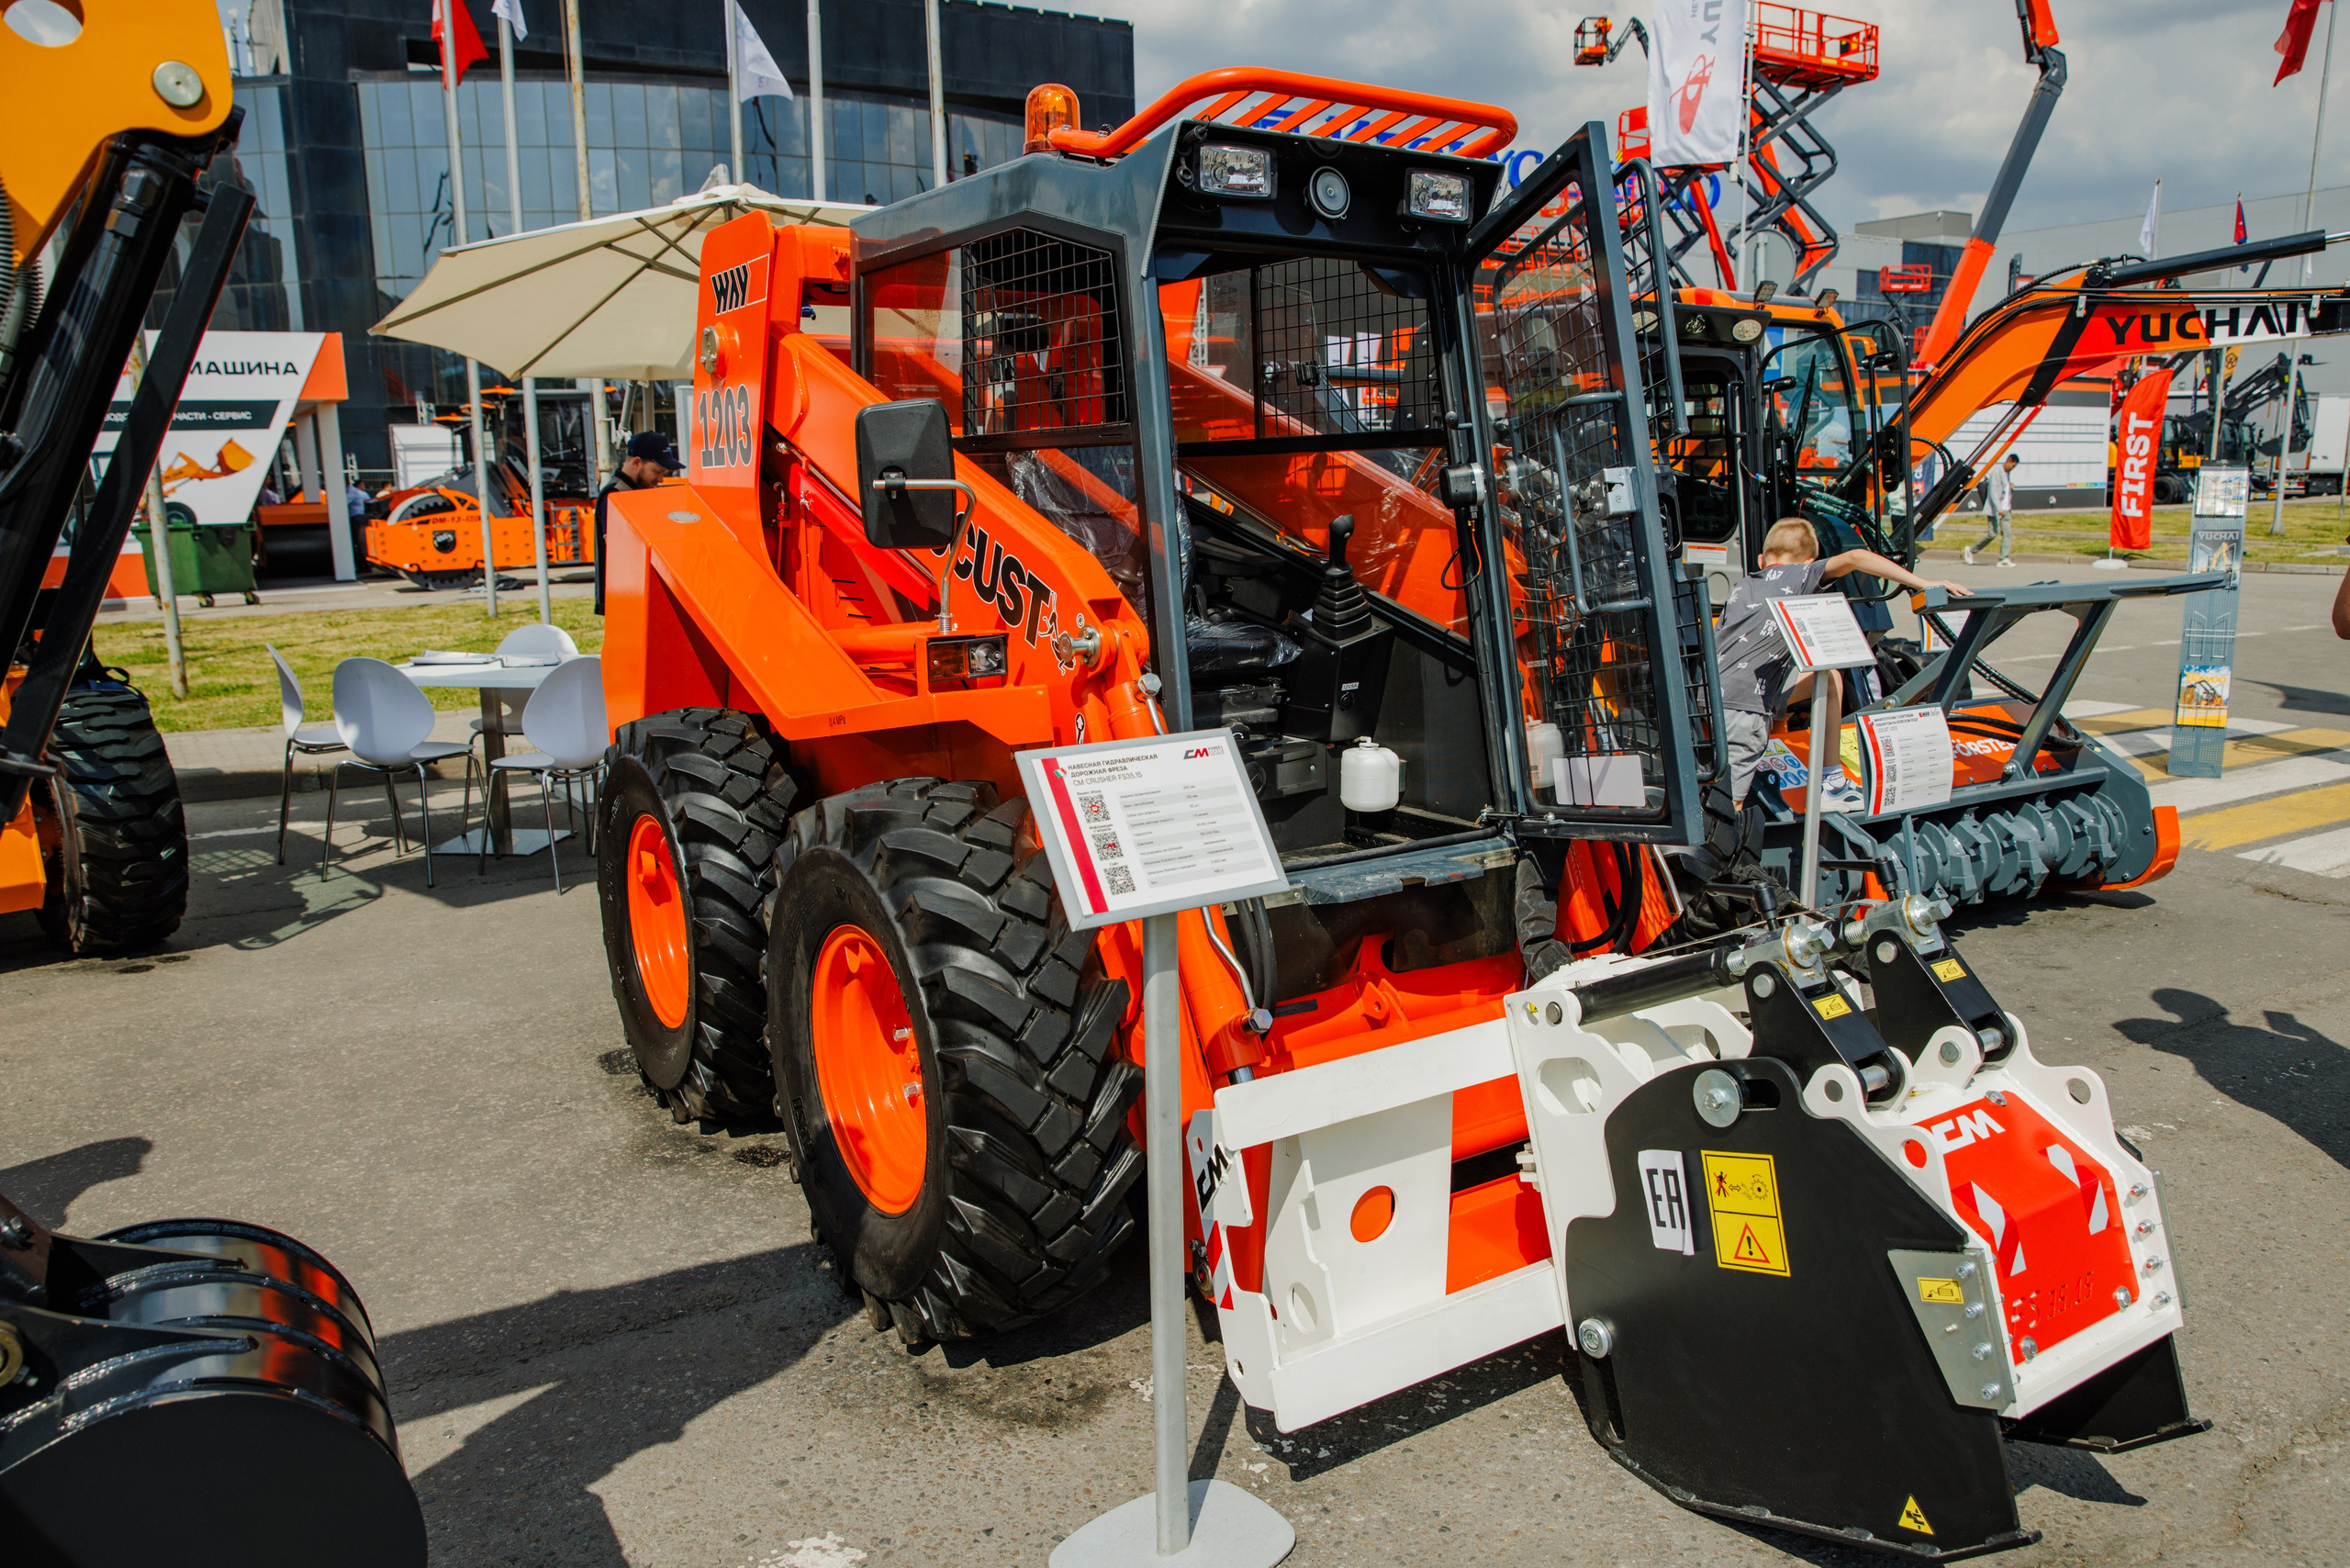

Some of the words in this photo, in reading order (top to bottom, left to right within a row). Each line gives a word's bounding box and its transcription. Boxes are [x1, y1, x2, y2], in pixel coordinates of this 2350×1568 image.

[711, 263, 749, 316] WAY
[699, 384, 753, 468] 1203
[2121, 411, 2153, 517] FIRST
[2198, 531, 2240, 541] YUCHAI
[1068, 759, 1102, 771] НАВЕСНАЯ
[1102, 754, 1158, 766] ГИДРАВЛИЧЕСКАЯ
[1183, 747, 1209, 759] CM
[1070, 767, 1107, 778] ДОРОЖНАЯ
[1085, 774, 1117, 785] CRUSHER
[1118, 770, 1143, 780] FS35.15
[1930, 1108, 2006, 1155] CM
[1197, 1144, 1229, 1213] CM
